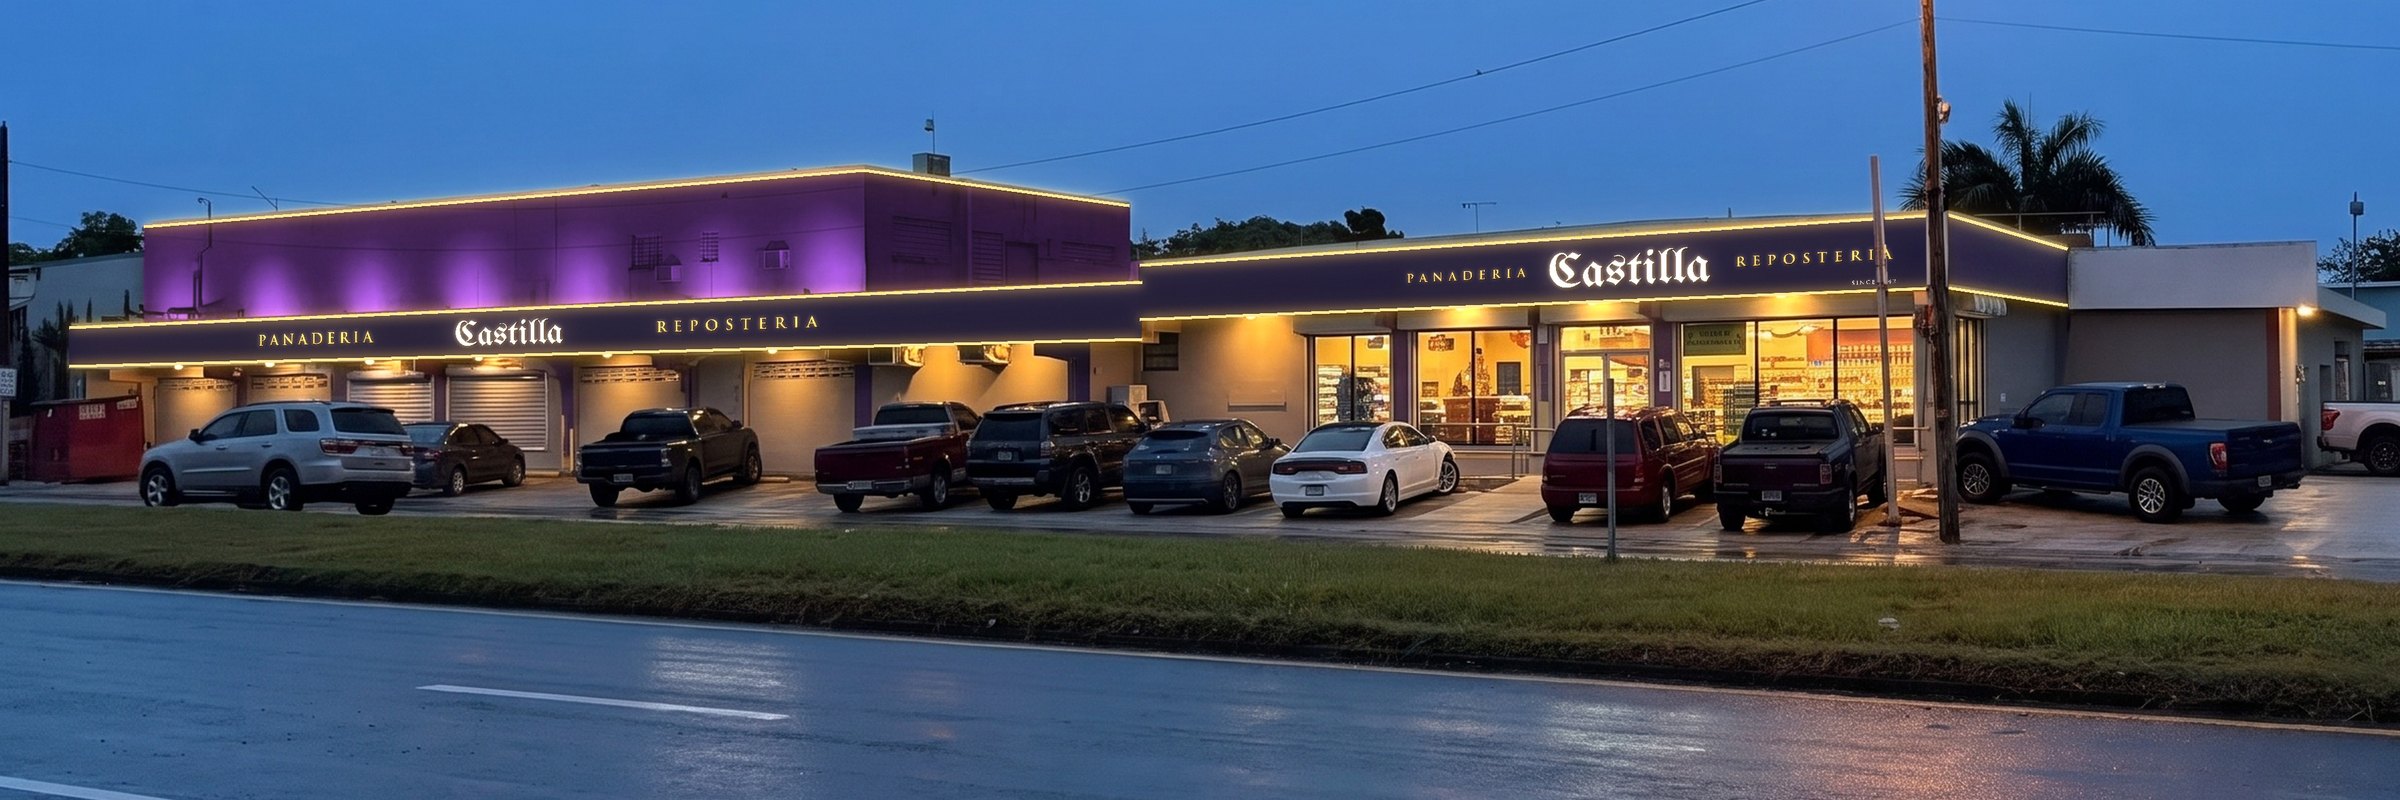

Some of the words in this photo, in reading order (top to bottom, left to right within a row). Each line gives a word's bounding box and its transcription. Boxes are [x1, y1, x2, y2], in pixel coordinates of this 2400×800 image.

[1407, 267, 1527, 284] PANADERIA
[1549, 246, 1711, 289] Castilla
[258, 330, 374, 347] PANADERIA
[455, 317, 564, 347] Castilla
[656, 315, 818, 333] REPOSTERIA
